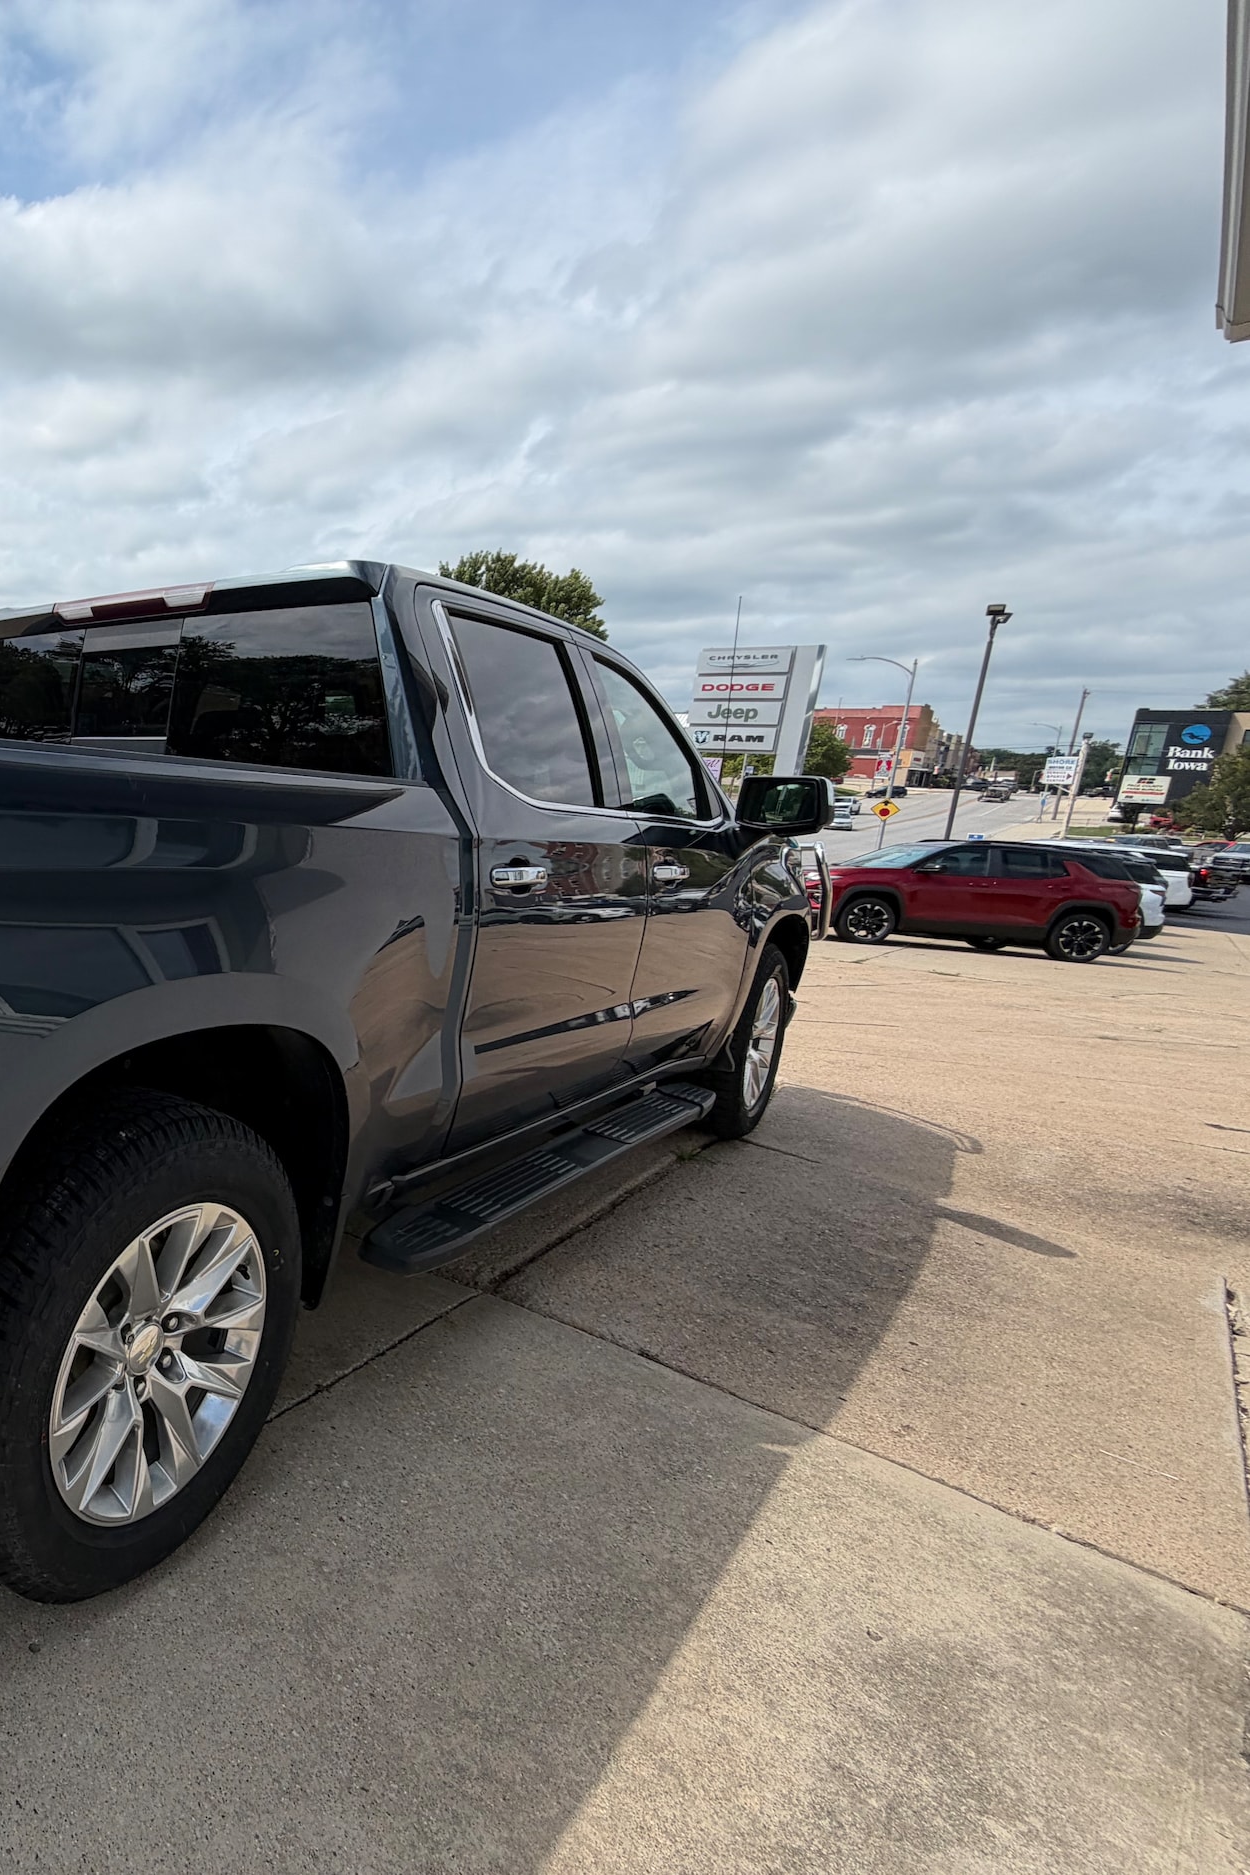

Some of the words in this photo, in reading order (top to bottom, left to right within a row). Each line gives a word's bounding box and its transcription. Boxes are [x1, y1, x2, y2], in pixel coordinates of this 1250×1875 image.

[701, 683, 776, 692] DODGE
[707, 704, 759, 722] Jeep
[713, 734, 765, 743] RAM
[1166, 746, 1216, 759] Bank
[1166, 758, 1208, 771] Iowa
